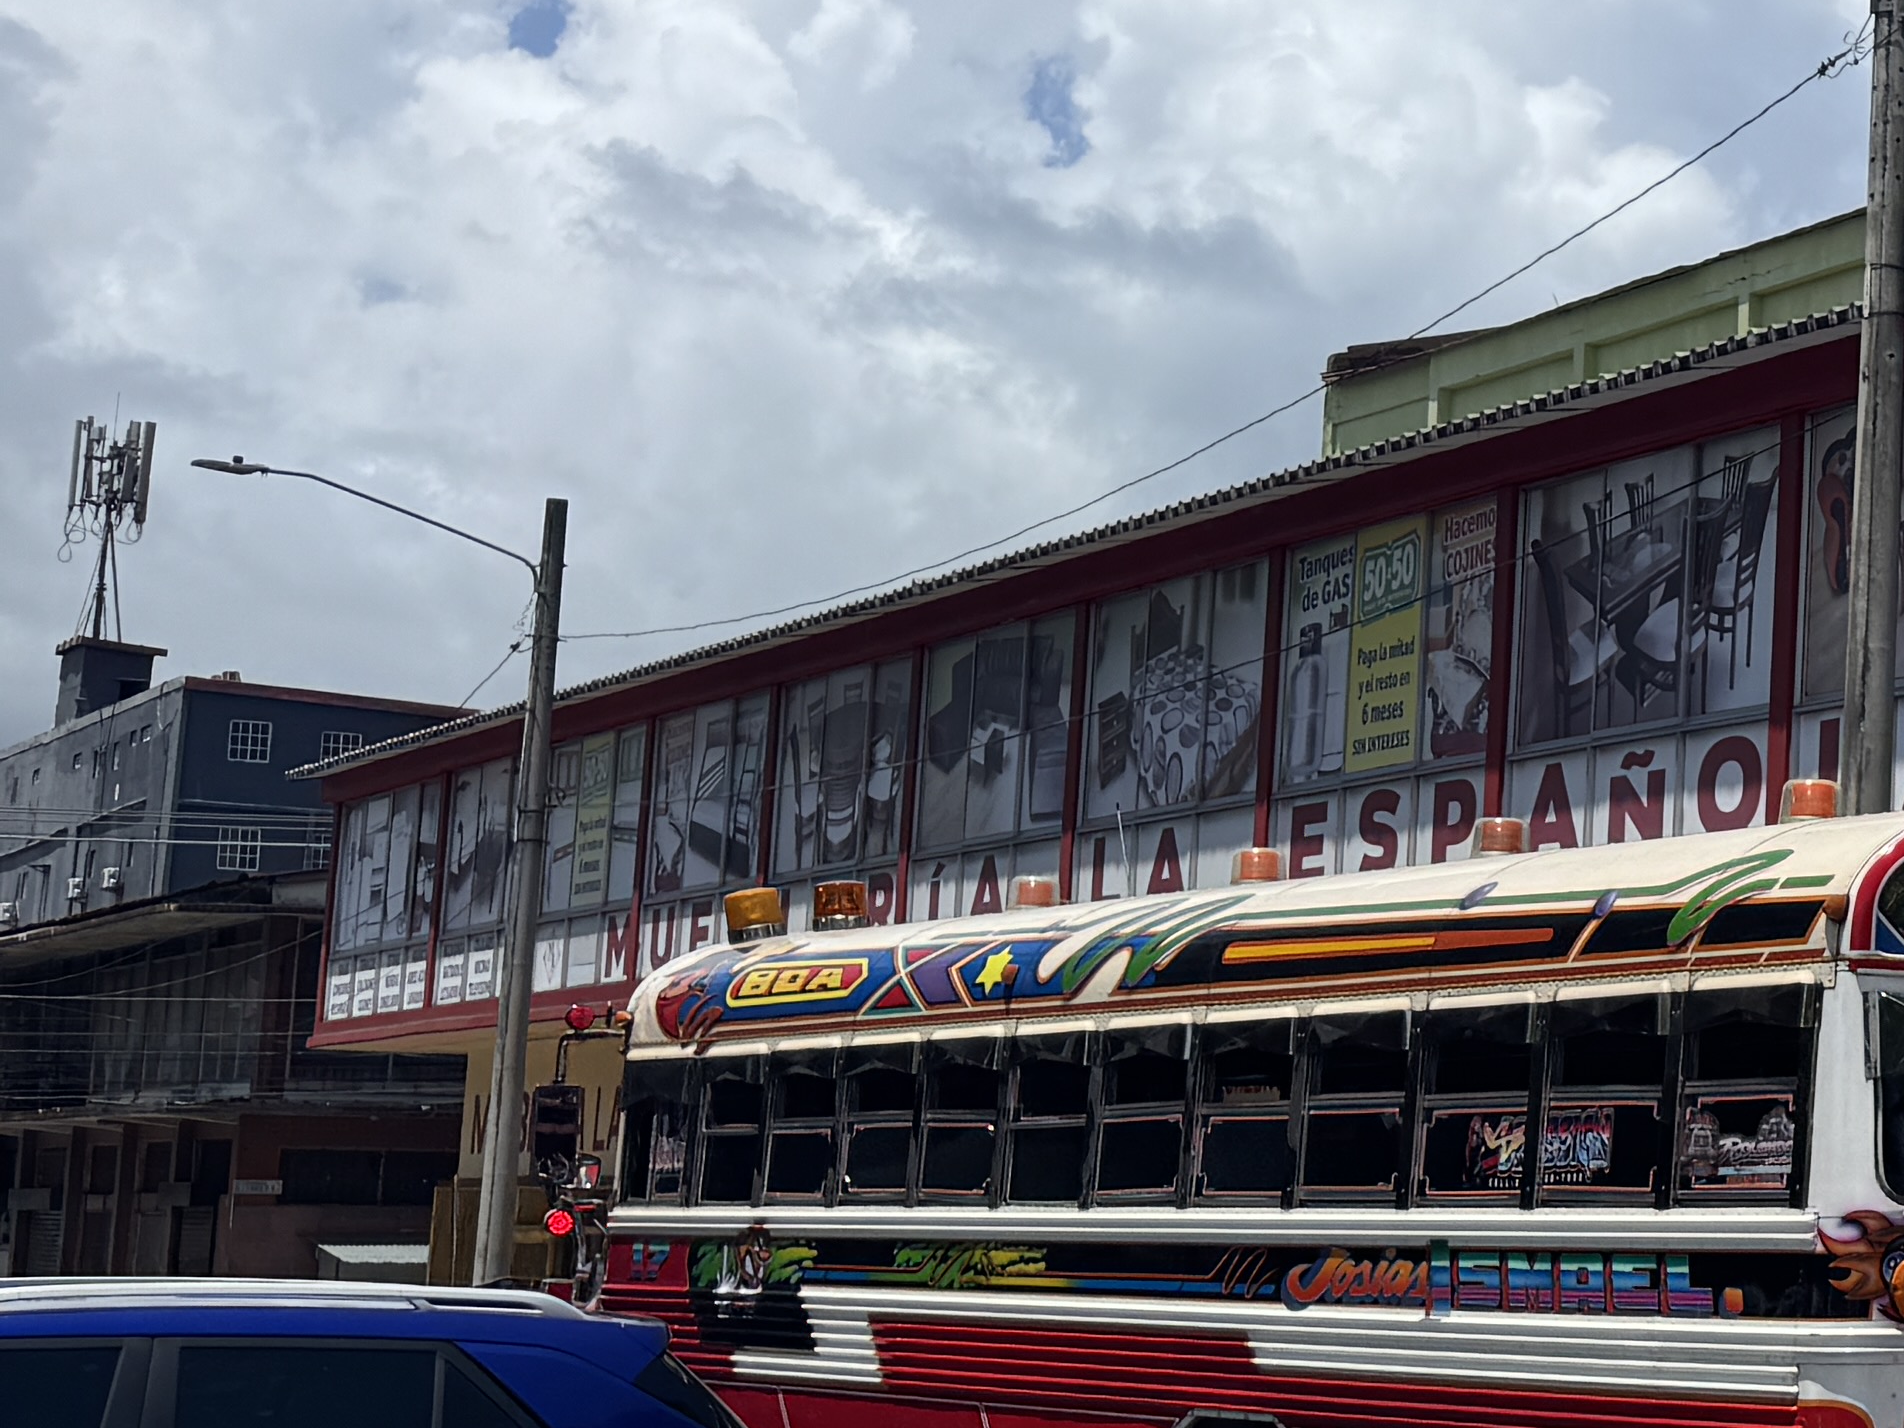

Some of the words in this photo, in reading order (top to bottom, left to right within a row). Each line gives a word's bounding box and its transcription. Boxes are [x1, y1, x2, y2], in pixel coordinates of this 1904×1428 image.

[1302, 587, 1320, 613] de
[1321, 573, 1350, 604] GAS
[1388, 635, 1415, 660] mitad
[1374, 673, 1398, 690] resto
[1399, 671, 1411, 686] en
[1362, 703, 1368, 725] 6
[1370, 701, 1404, 722] meses
[605, 854, 1003, 985] MUERÍA
[1092, 827, 1185, 901] LA
[737, 966, 844, 998] BOA
[1284, 1247, 1428, 1305] Josias
